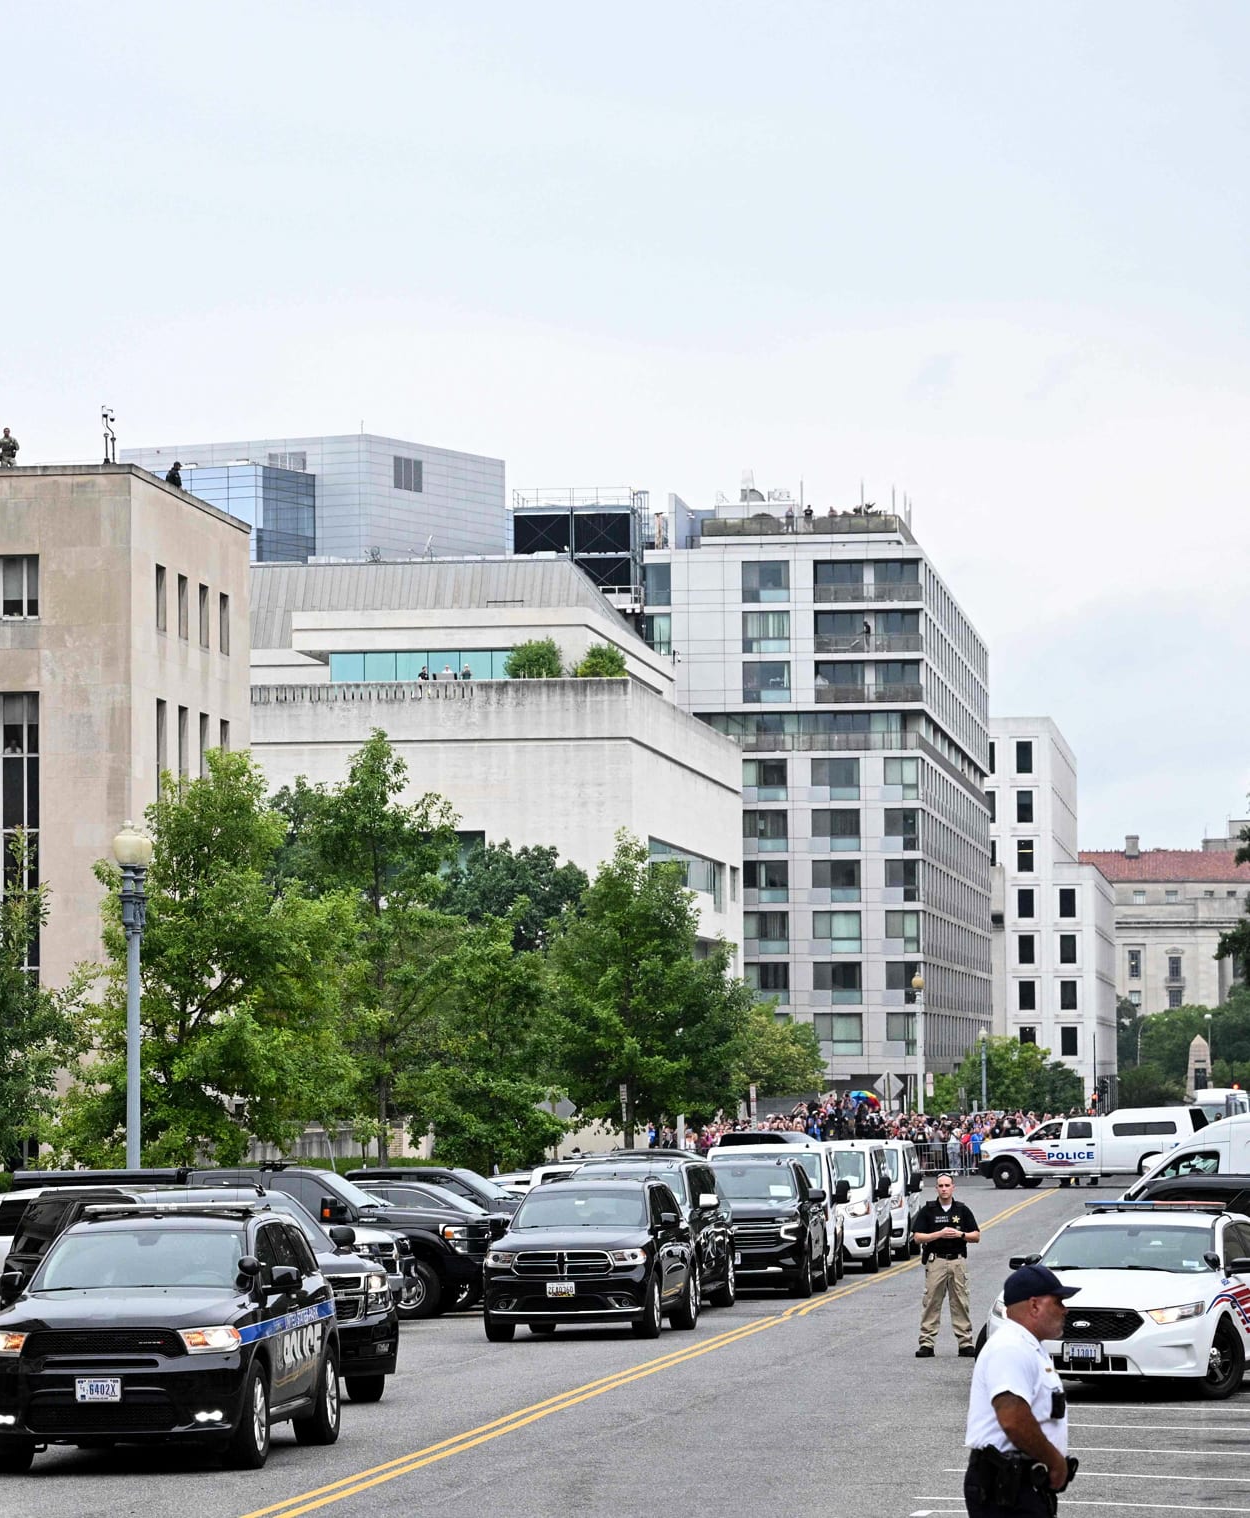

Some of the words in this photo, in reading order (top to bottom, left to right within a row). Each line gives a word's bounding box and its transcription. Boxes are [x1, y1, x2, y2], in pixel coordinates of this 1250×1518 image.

[1047, 1151, 1095, 1160] POLICE
[284, 1322, 322, 1364] POLICE
[89, 1384, 116, 1395] 6402X
